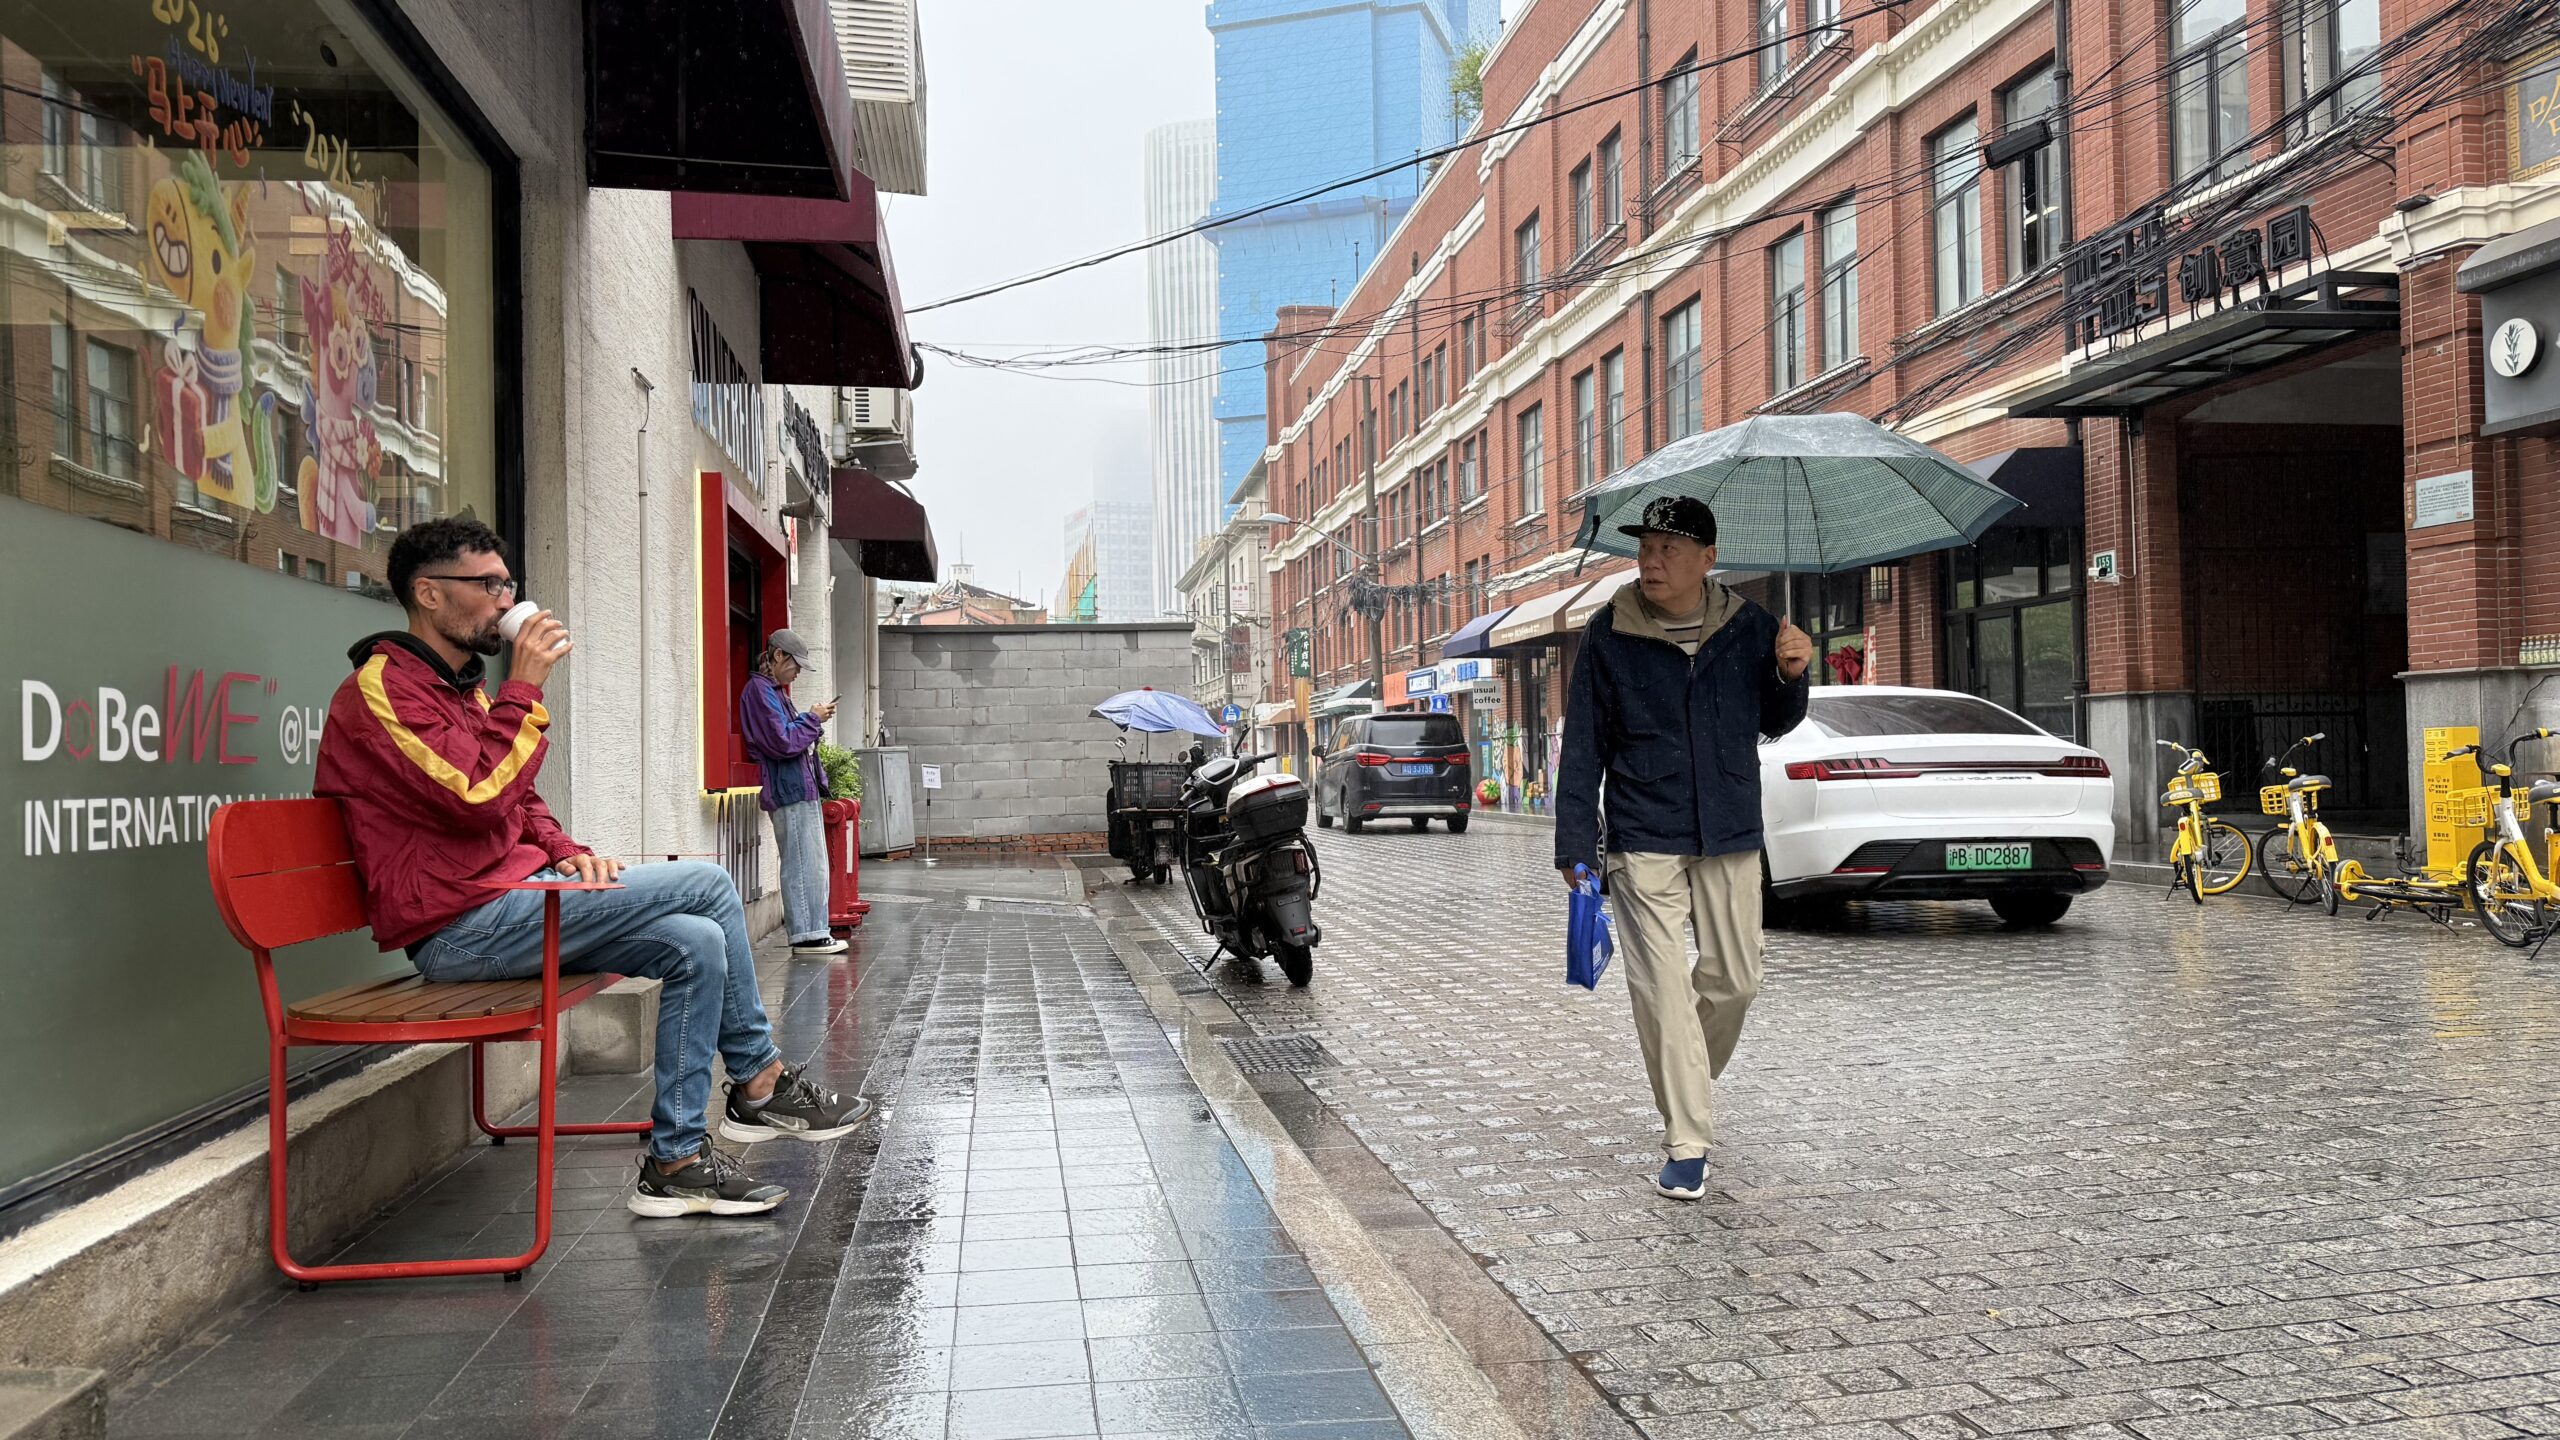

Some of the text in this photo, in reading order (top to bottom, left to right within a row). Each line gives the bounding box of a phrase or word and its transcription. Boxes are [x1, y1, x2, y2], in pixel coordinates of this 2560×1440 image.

[303, 111, 352, 191] 2026
[2098, 556, 2110, 568] 155
[1474, 685, 1496, 694] usual
[1474, 696, 1501, 704] coffee
[280, 705, 323, 765] @H
